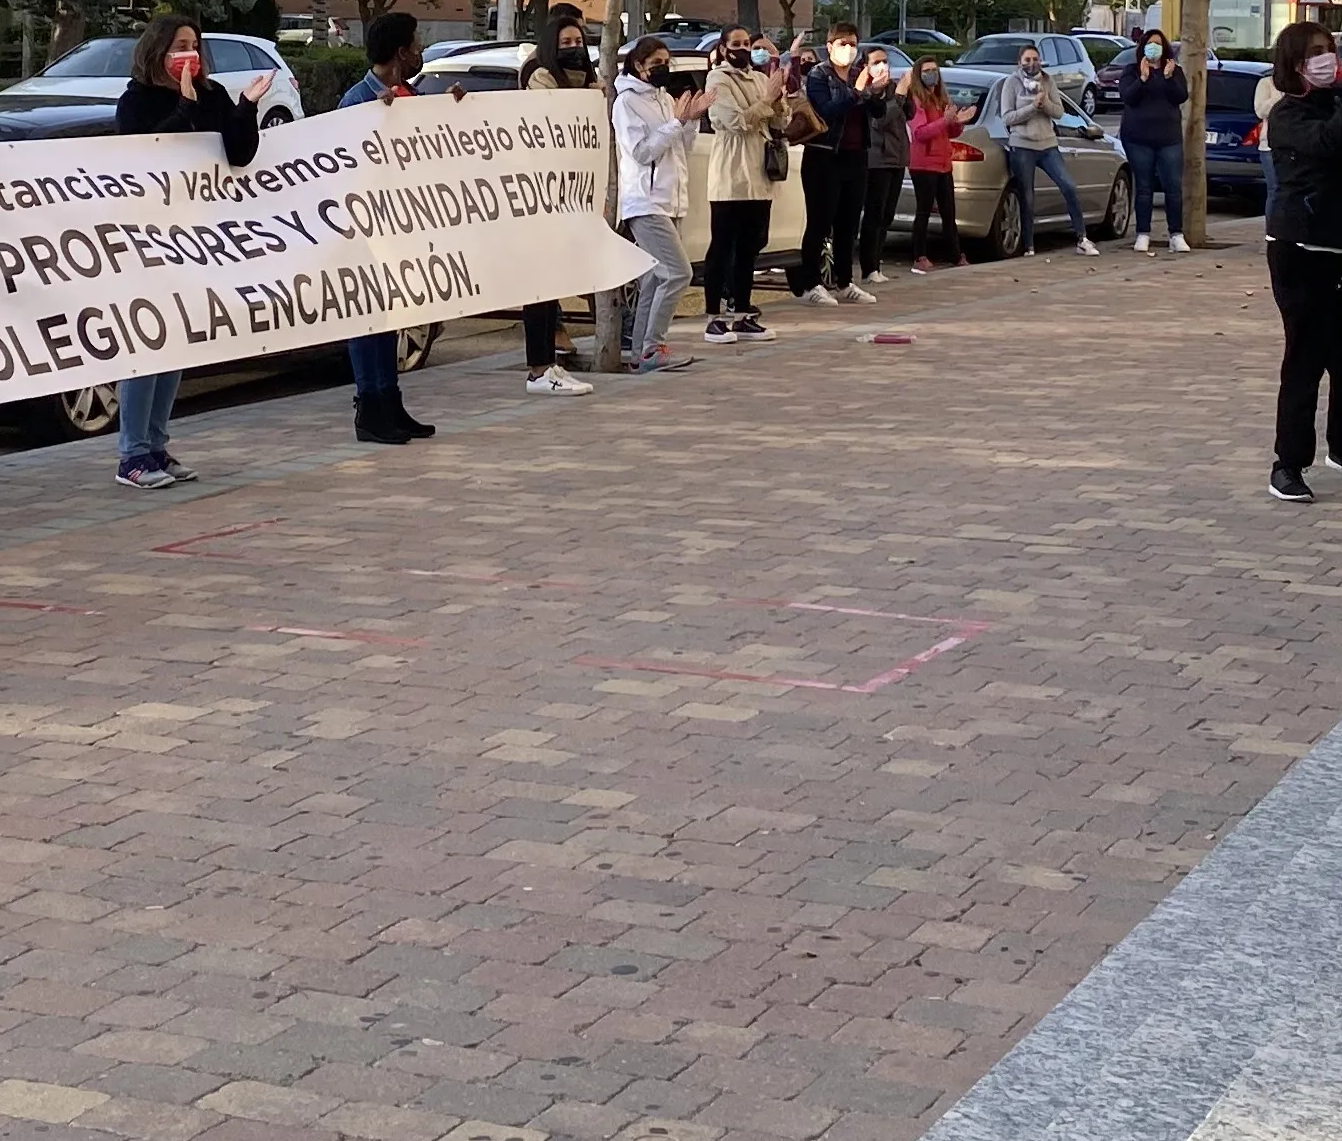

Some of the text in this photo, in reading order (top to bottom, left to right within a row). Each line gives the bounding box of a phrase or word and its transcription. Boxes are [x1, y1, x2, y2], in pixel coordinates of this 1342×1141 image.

[147, 170, 172, 206] y
[180, 144, 358, 203] valoremos
[361, 129, 390, 165] el
[390, 119, 514, 171] privilegio
[517, 116, 546, 150] de
[545, 116, 566, 149] la
[568, 116, 602, 150] vida.
[271, 210, 319, 245] Y
[318, 177, 501, 240] COMUNIDAD
[500, 170, 596, 218] EDUCATIVA
[172, 287, 237, 344] LA
[235, 241, 481, 334] ENCARNACIÓN.
